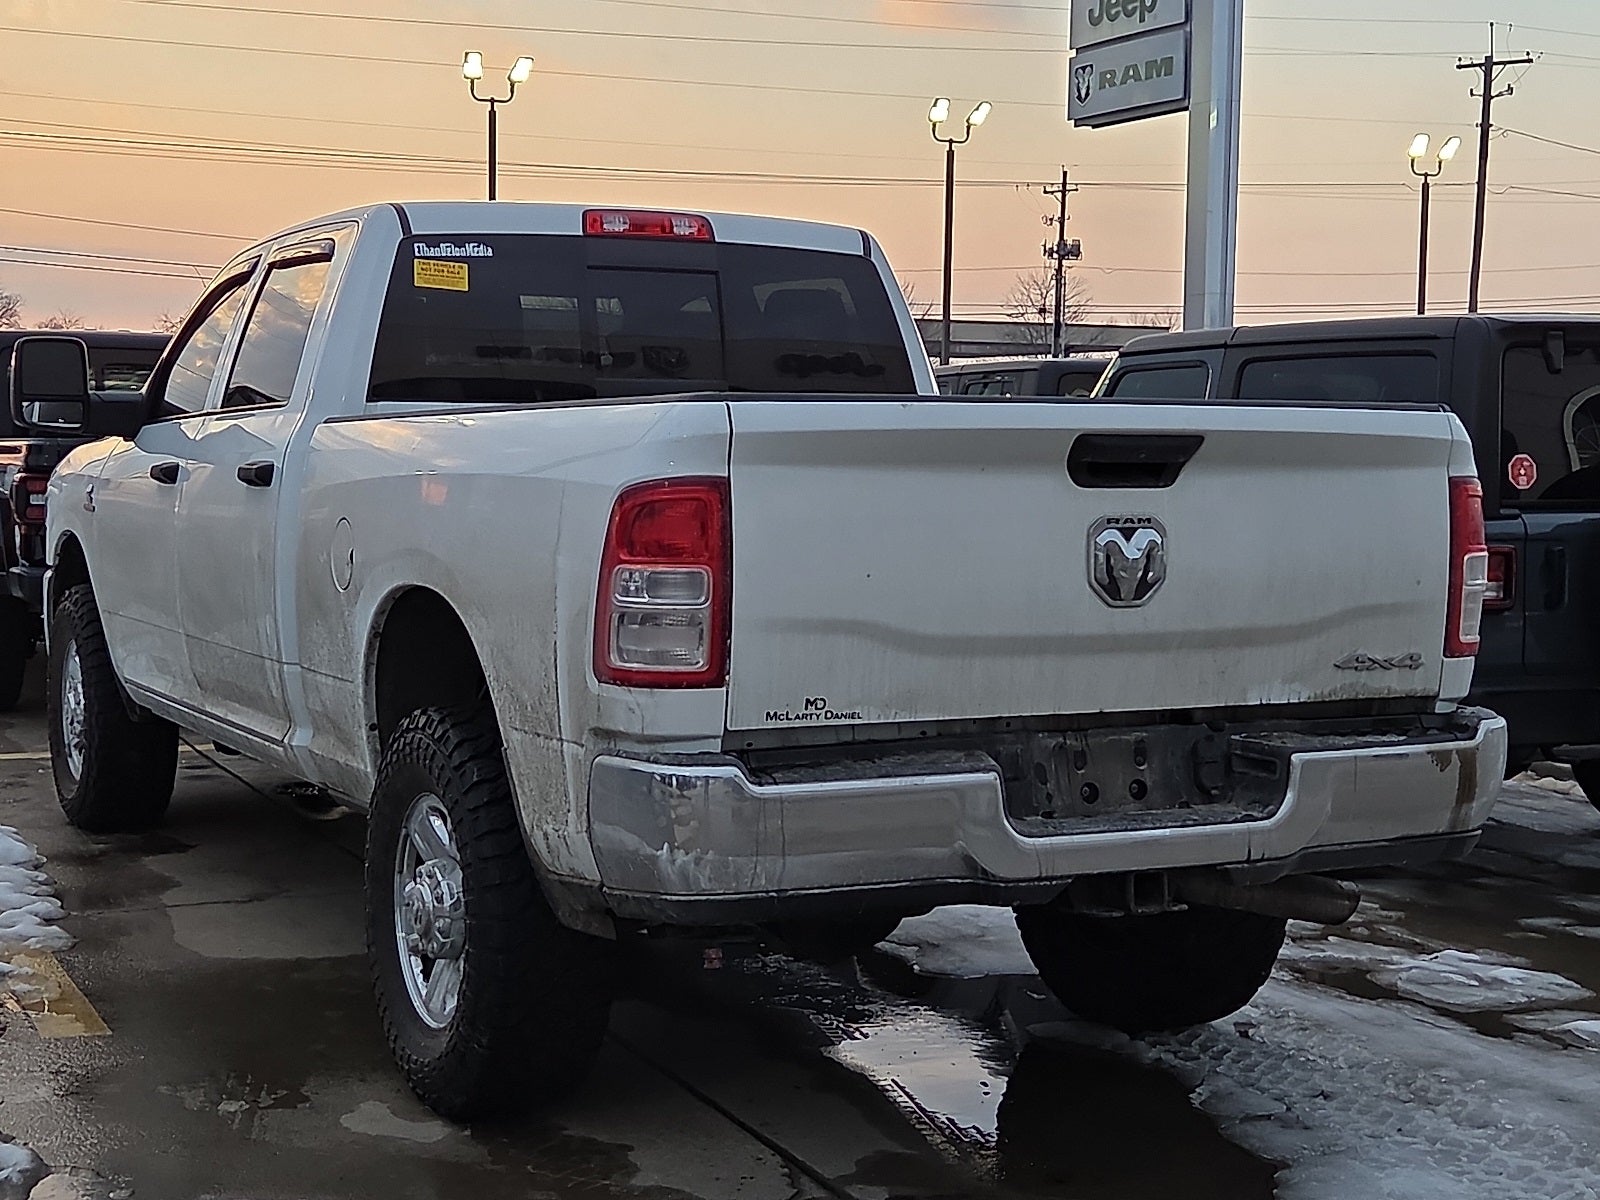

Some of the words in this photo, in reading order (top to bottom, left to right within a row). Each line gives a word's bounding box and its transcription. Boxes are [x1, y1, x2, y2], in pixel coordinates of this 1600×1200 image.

[1088, 0, 1158, 27] Jeep
[1098, 56, 1174, 90] RAM
[1106, 517, 1152, 525] RAM
[804, 697, 827, 711] MD
